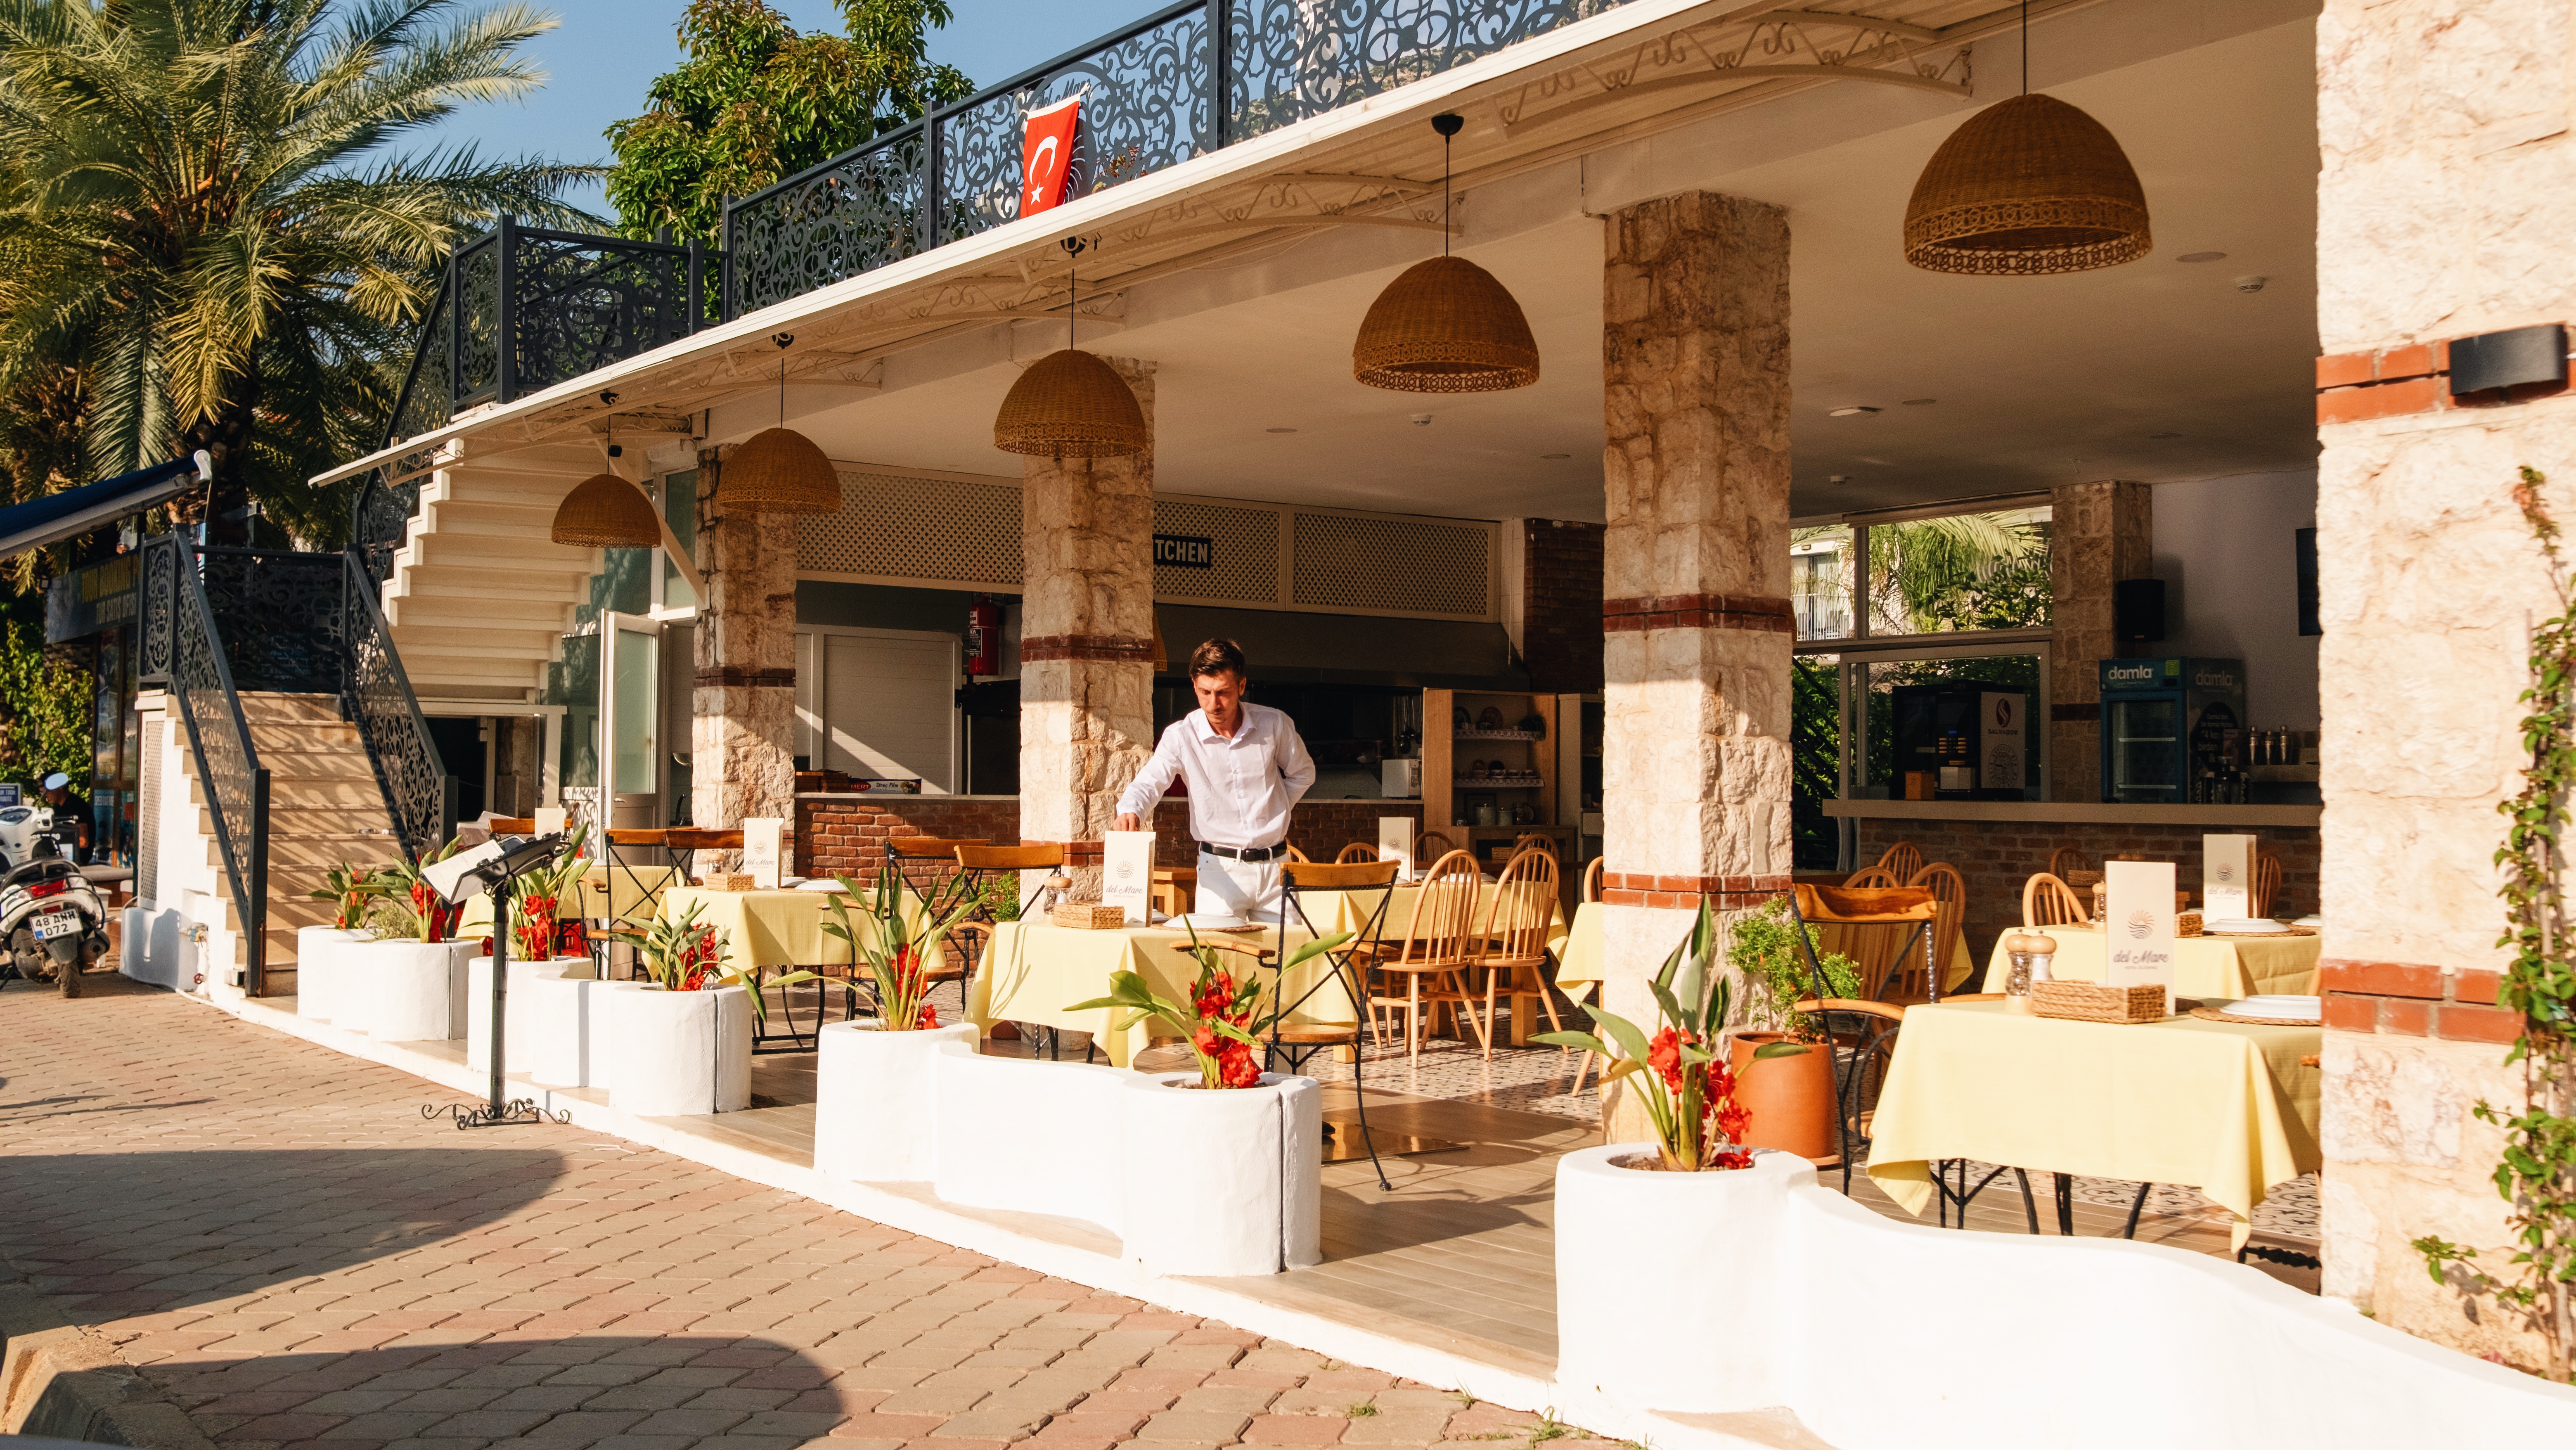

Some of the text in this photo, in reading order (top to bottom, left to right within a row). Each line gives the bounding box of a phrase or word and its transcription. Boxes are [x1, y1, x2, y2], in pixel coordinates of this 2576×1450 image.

[1153, 539, 1208, 563] TCHEN
[82, 568, 97, 603] TOUR
[97, 601, 105, 625] TUR
[2108, 665, 2153, 680] damla
[2195, 668, 2233, 686] damla
[1118, 885, 1143, 894] Mare
[36, 910, 76, 927] 48 ANH
[45, 924, 69, 936] 072
[2113, 950, 2169, 964] del Mare
